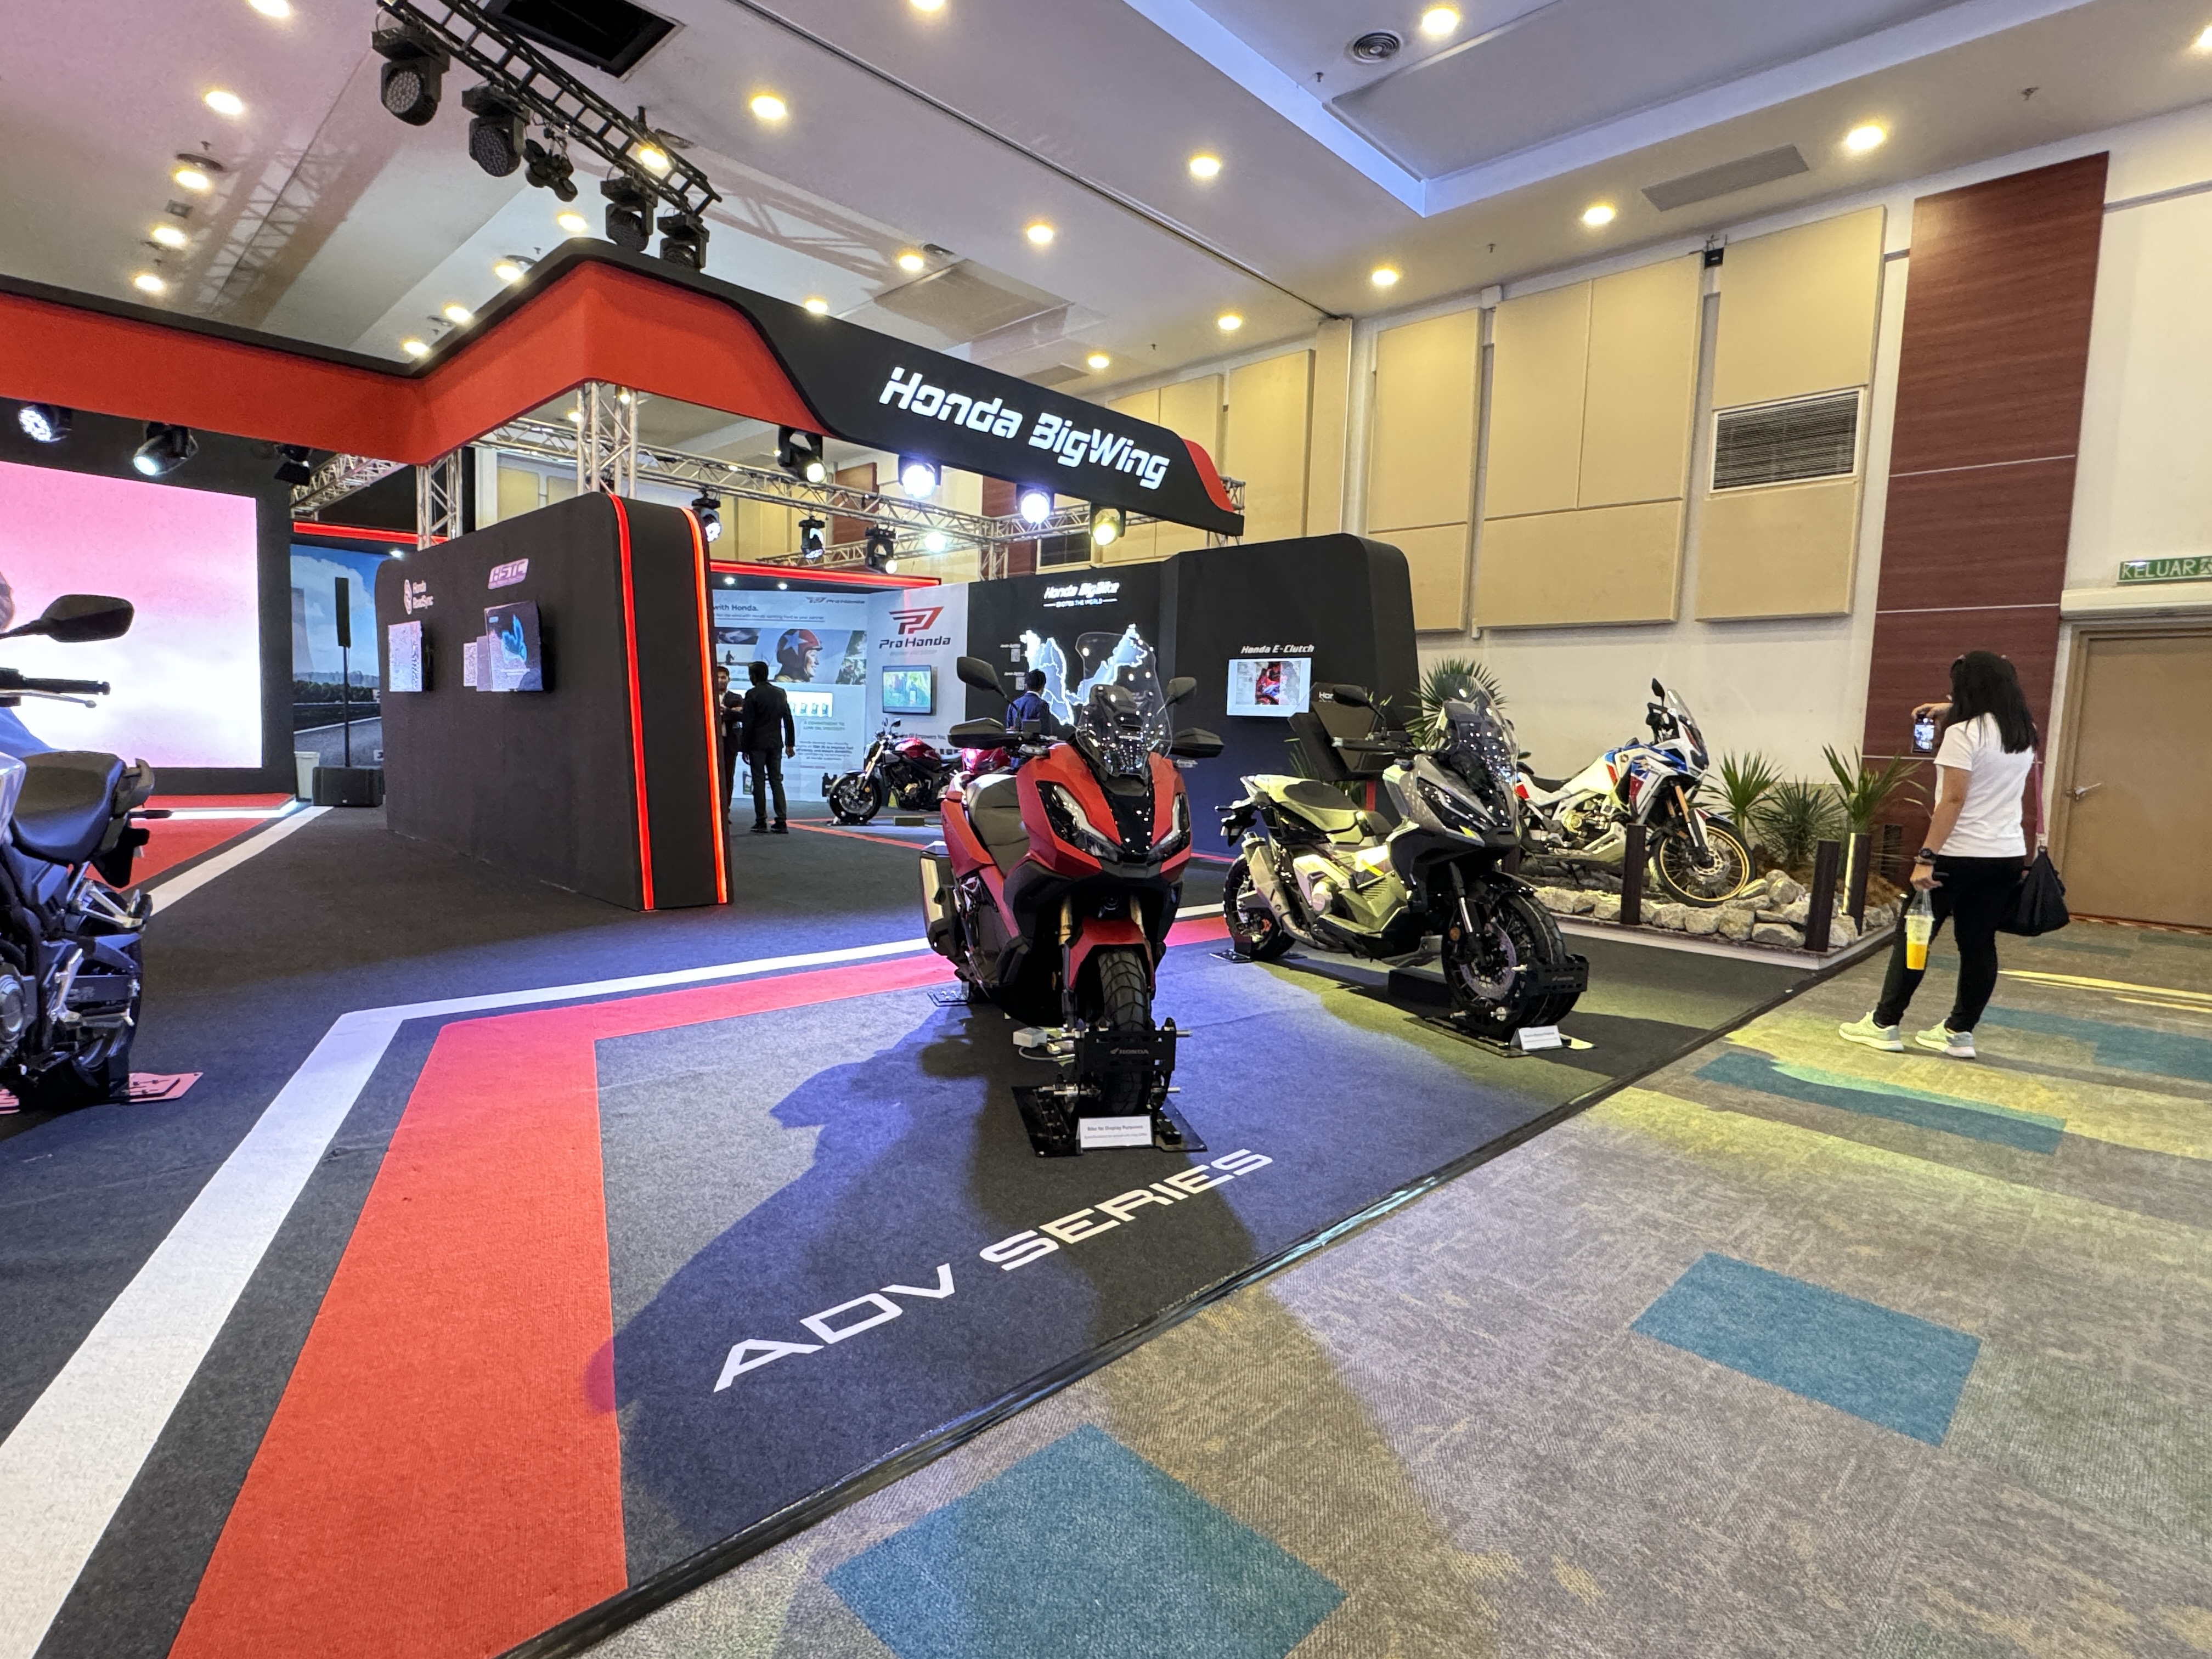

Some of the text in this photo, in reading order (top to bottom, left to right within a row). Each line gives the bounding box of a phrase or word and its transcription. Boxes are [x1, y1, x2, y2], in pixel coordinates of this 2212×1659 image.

[879, 366, 1171, 490] Honda BigWing
[2121, 558, 2197, 579] KELUAR
[879, 635, 951, 649] Pro Honda
[1240, 644, 1314, 654] Honda E-Clutch
[713, 1149, 1273, 1393] ADV SERIES
